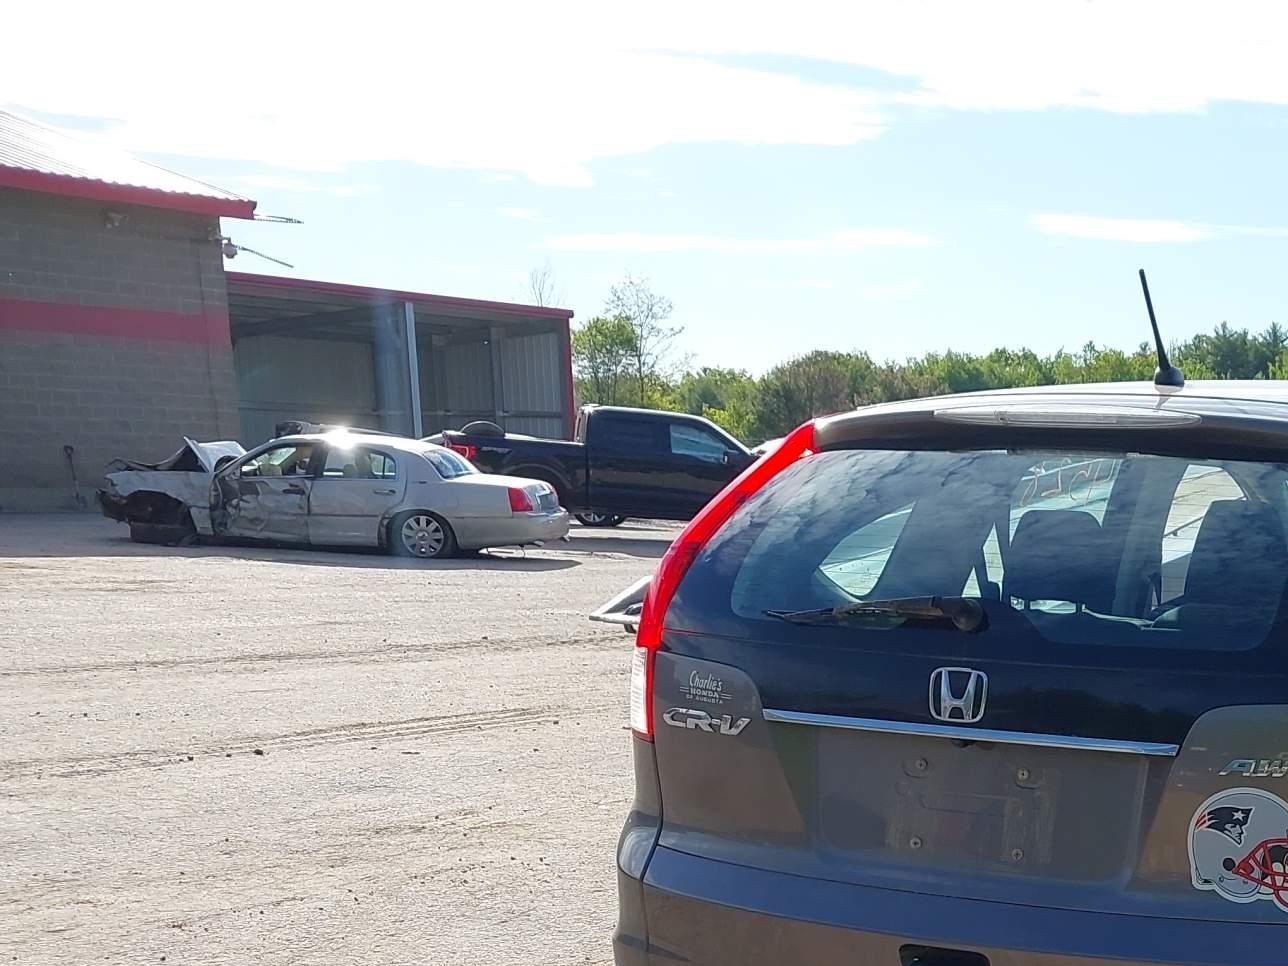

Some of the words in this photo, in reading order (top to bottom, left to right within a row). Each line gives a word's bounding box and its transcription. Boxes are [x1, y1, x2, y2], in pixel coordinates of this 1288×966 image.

[689, 670, 723, 692] Charlie's
[690, 687, 719, 699] HONDA
[663, 707, 752, 736] CR-V
